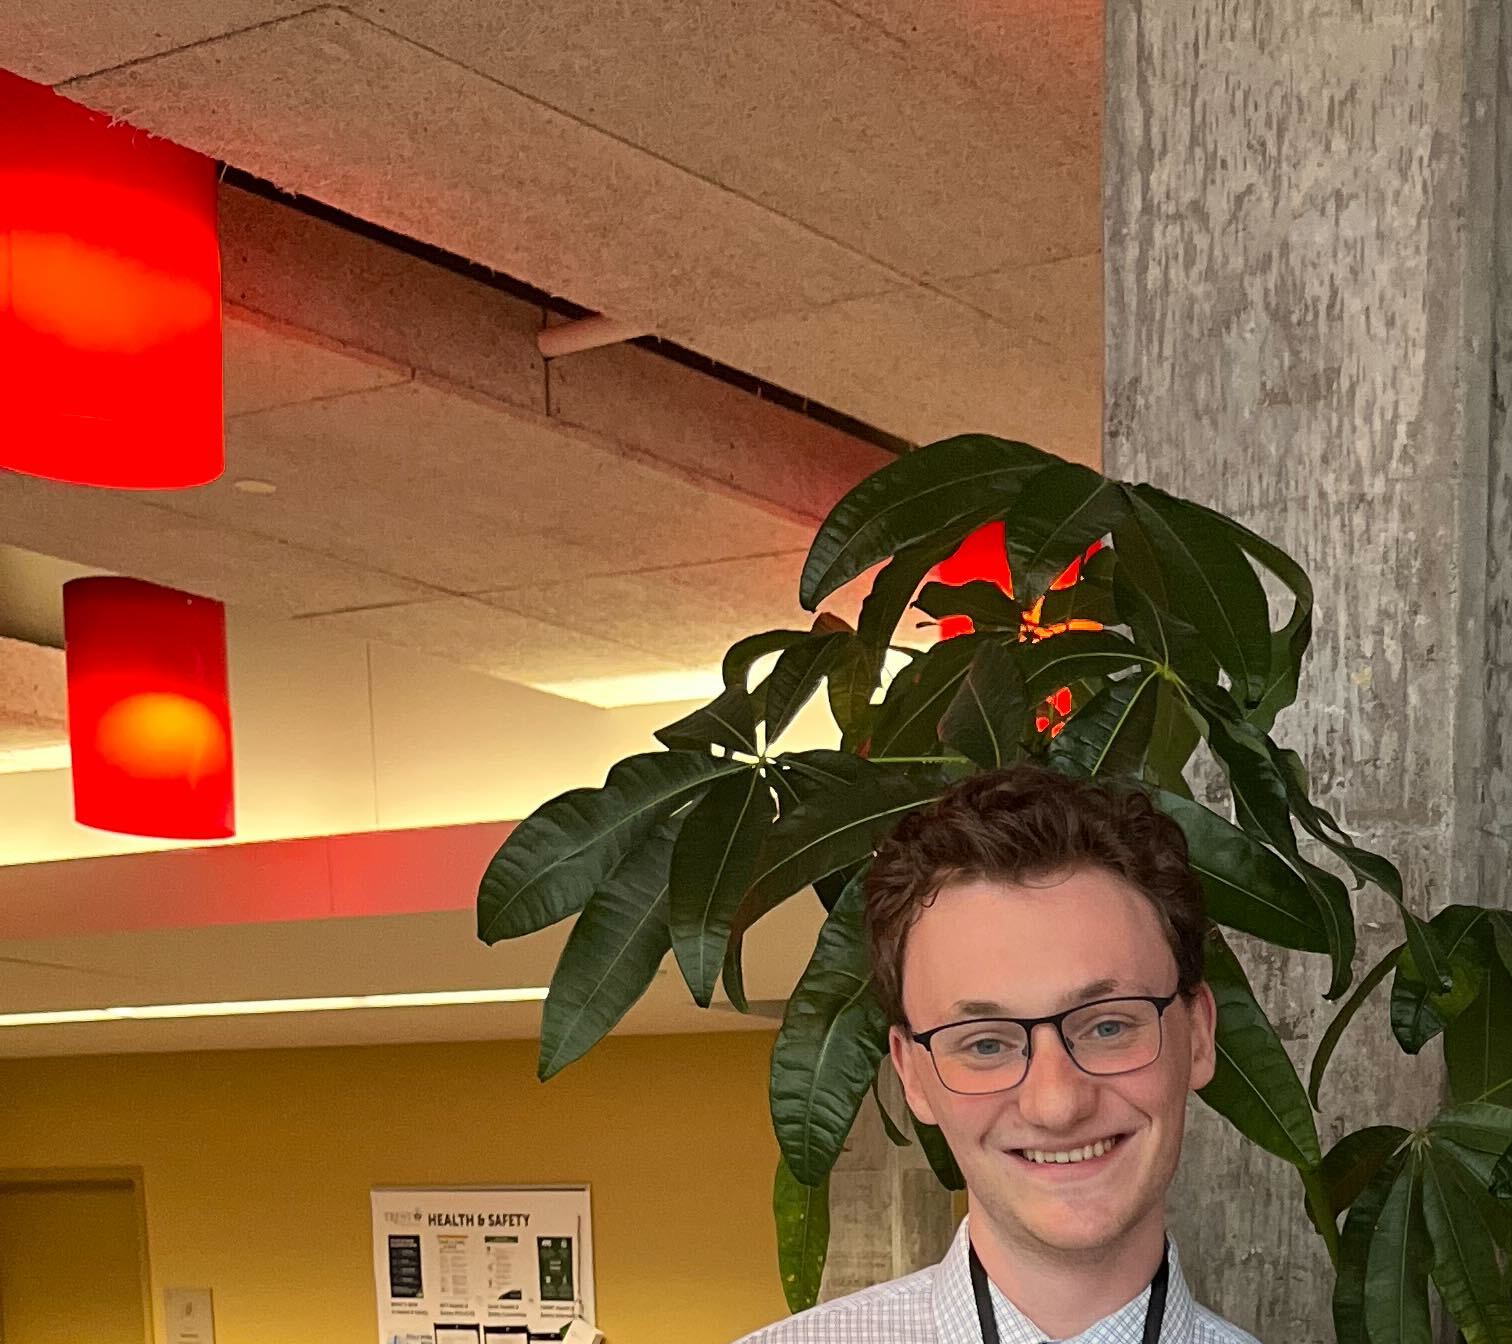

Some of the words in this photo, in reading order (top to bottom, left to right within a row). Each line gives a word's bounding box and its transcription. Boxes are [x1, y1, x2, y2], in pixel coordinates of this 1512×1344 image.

[428, 1213, 474, 1227] HEALTH
[477, 1213, 485, 1226] &
[488, 1213, 530, 1227] SAFETY
